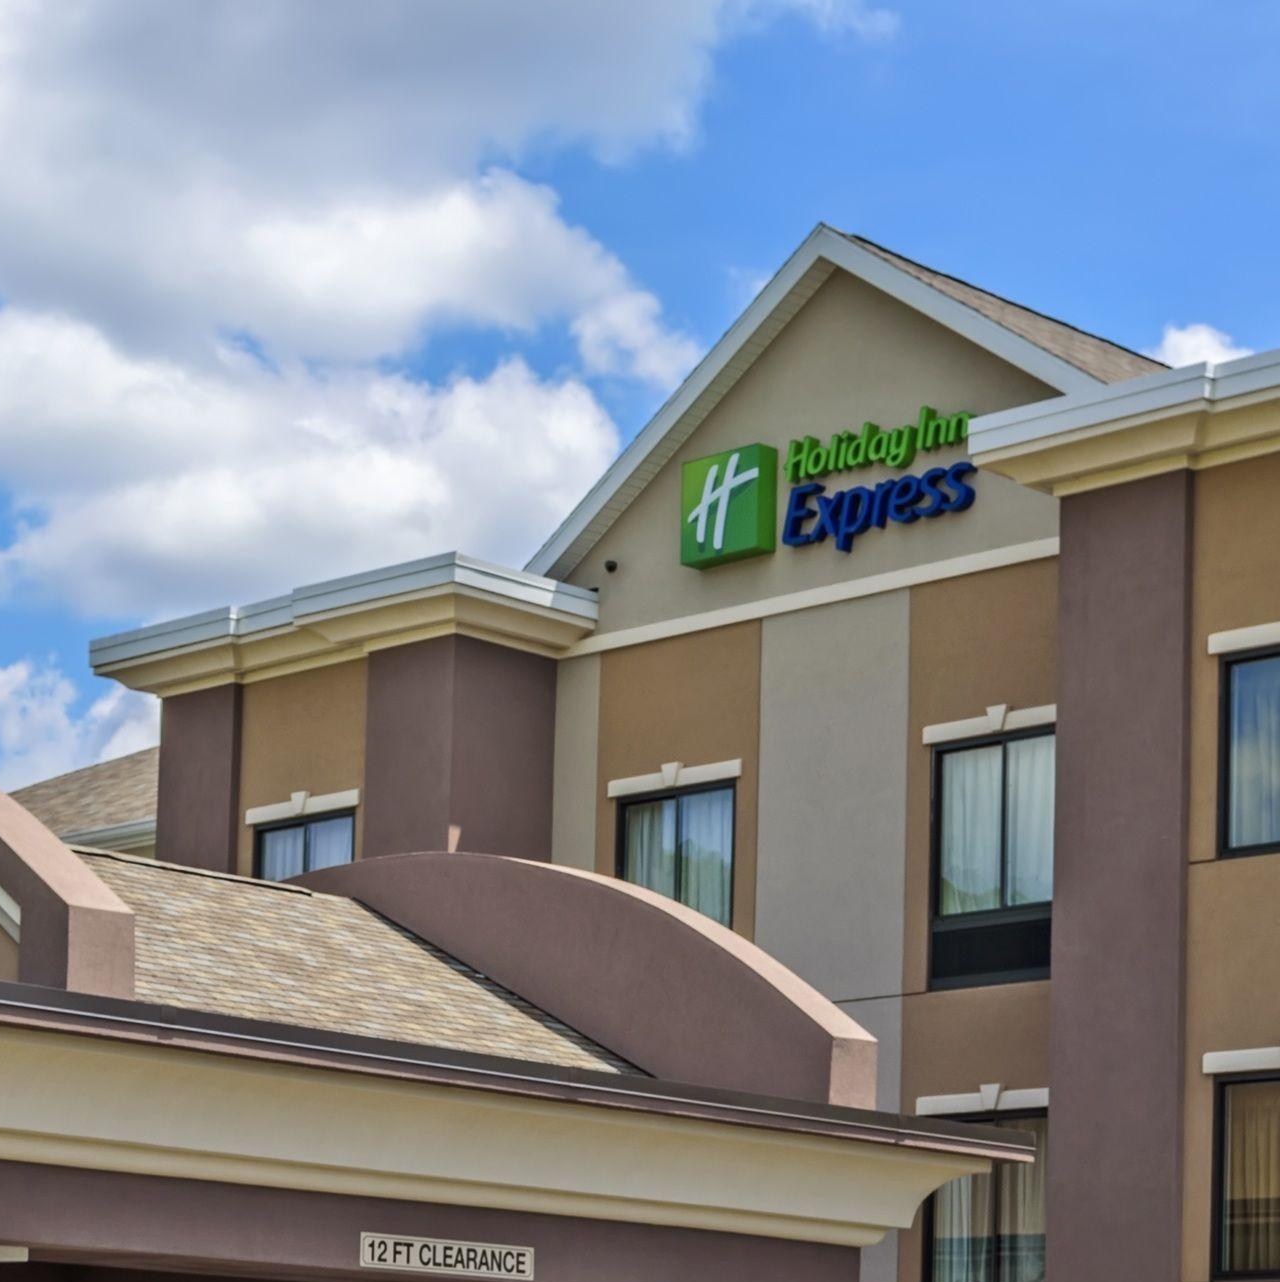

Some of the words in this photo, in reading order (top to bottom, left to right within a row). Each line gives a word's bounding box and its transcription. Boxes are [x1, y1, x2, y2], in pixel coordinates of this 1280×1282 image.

[784, 421, 916, 483] Holiday
[916, 406, 975, 451] Inn
[783, 461, 977, 552] Express
[368, 1240, 388, 1263] 12
[393, 1241, 414, 1265] FT
[419, 1244, 526, 1274] CLEARANCE
